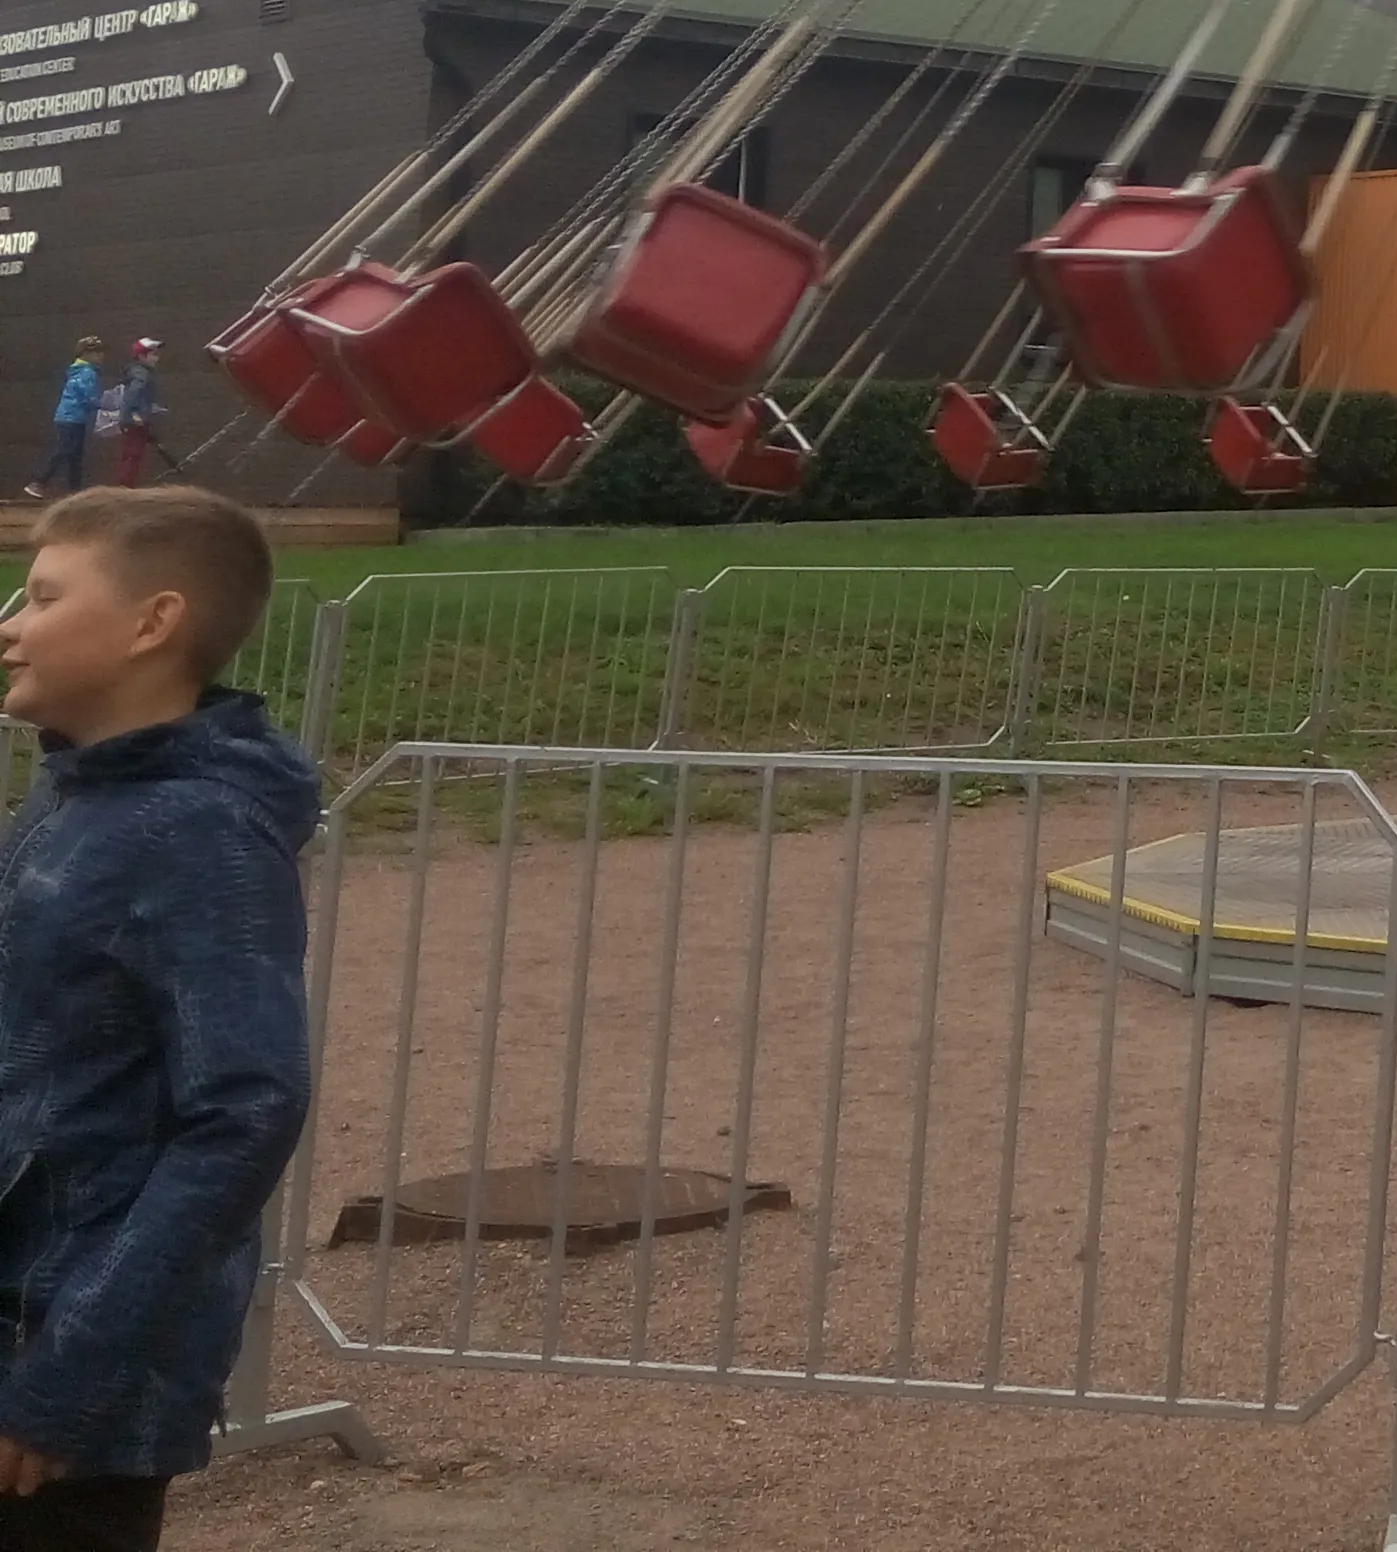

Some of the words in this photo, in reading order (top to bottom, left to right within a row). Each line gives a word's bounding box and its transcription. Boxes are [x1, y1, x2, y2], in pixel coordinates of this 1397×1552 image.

[94, 9, 138, 41] ЦЕНТР
[6, 86, 106, 124] СОВРЕМЕННОГО
[107, 74, 186, 108] ИСКУССТВА
[187, 64, 248, 94] «ГАРАЖ»
[15, 165, 63, 192] ШКОЛА
